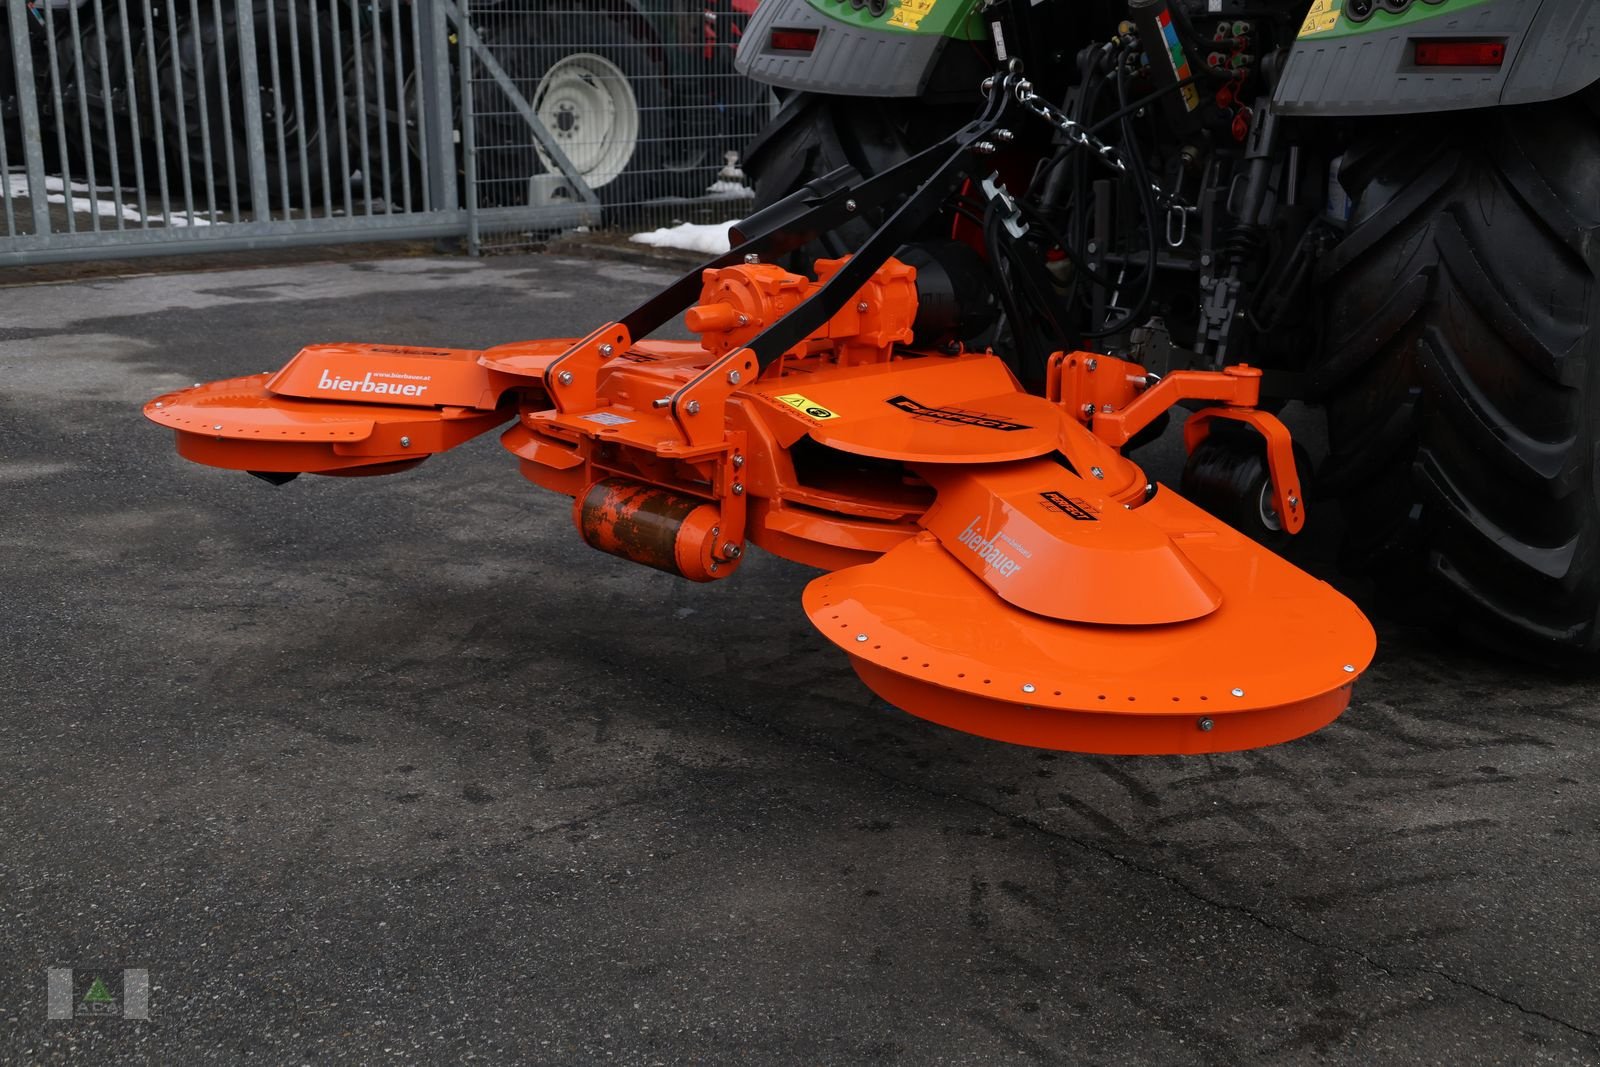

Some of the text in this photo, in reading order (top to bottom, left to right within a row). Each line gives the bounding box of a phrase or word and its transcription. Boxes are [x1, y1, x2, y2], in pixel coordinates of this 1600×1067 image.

[317, 369, 428, 397] bierbauer
[896, 400, 1017, 429] PERFECT
[1043, 492, 1090, 520] PERFECT
[957, 515, 1021, 578] bierbauer
